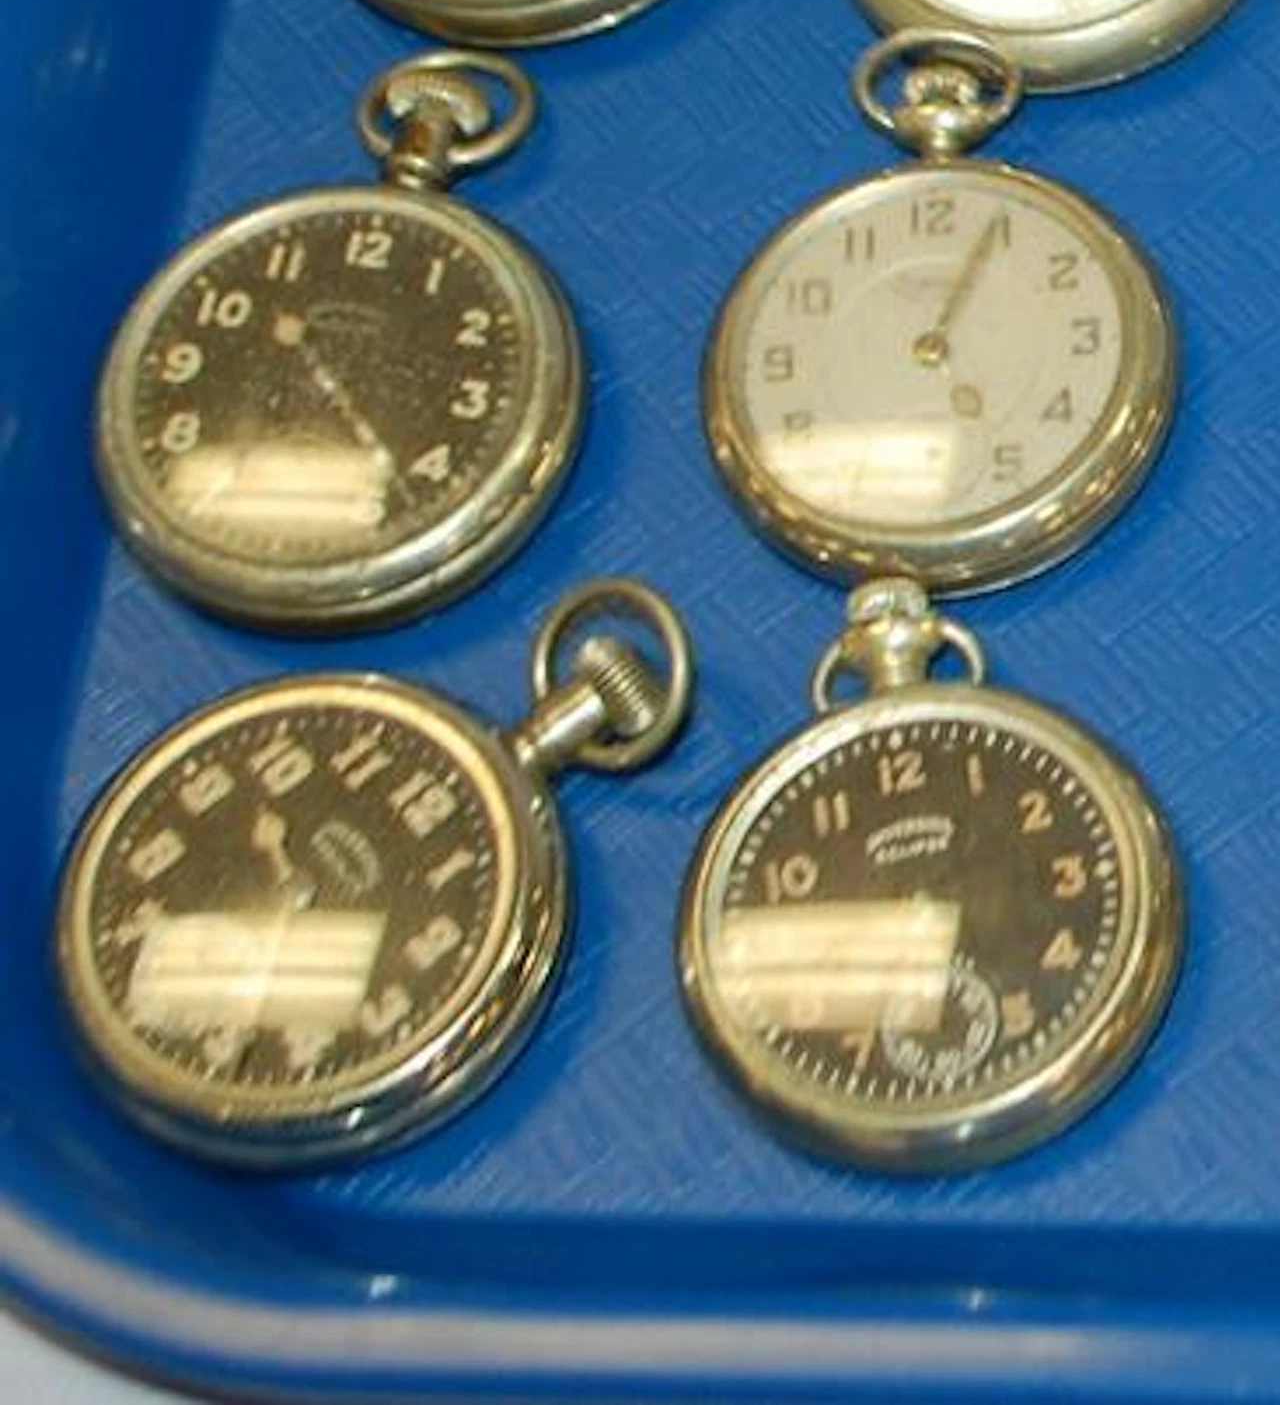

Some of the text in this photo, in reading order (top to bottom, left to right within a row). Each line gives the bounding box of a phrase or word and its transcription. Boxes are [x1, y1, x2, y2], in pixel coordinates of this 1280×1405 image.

[909, 201, 956, 236] 12
[266, 242, 306, 282] 11
[344, 230, 393, 270] 12
[843, 227, 876, 262] 11
[424, 258, 446, 294] 1
[1047, 254, 1079, 292] 2
[196, 290, 253, 327] 10
[786, 278, 833, 316] 10
[456, 309, 492, 347] 2
[1070, 317, 1100, 357] 3
[163, 343, 203, 383] 9
[763, 345, 794, 383] 9
[449, 380, 489, 419] 3
[1041, 387, 1073, 423] 4
[161, 411, 201, 452] 8
[410, 444, 450, 482] 4
[993, 443, 1022, 482] 5
[249, 737, 315, 796] 10
[330, 733, 394, 792] 11
[878, 751, 926, 795] 12
[966, 754, 986, 794] 1
[179, 763, 236, 817] 9
[389, 770, 459, 837] 12
[812, 793, 851, 837] 11
[1019, 791, 1053, 833] 2
[426, 848, 475, 891] 1
[765, 855, 818, 903] 10
[1052, 855, 1087, 897] 3
[1039, 928, 1083, 971] 4
[1002, 991, 1035, 1036] 5
[841, 1031, 877, 1071] 7
